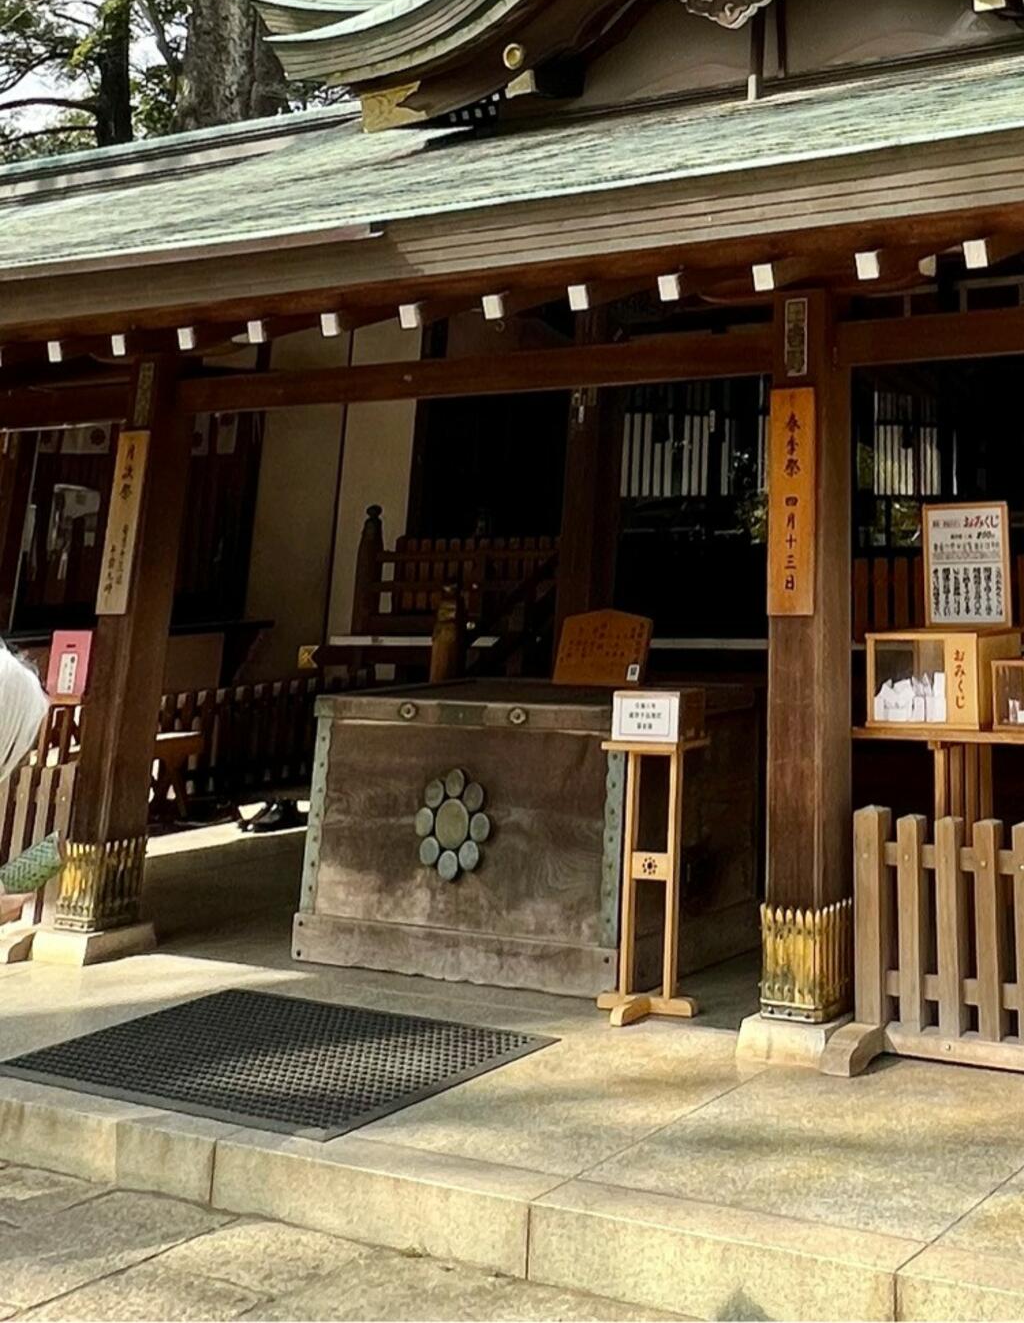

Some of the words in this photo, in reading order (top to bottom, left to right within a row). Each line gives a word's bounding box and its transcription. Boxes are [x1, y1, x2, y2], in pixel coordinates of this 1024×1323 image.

[783, 413, 801, 477] 春季祭
[783, 495, 799, 591] 四月十三日
[953, 648, 966, 710] おみくじ
